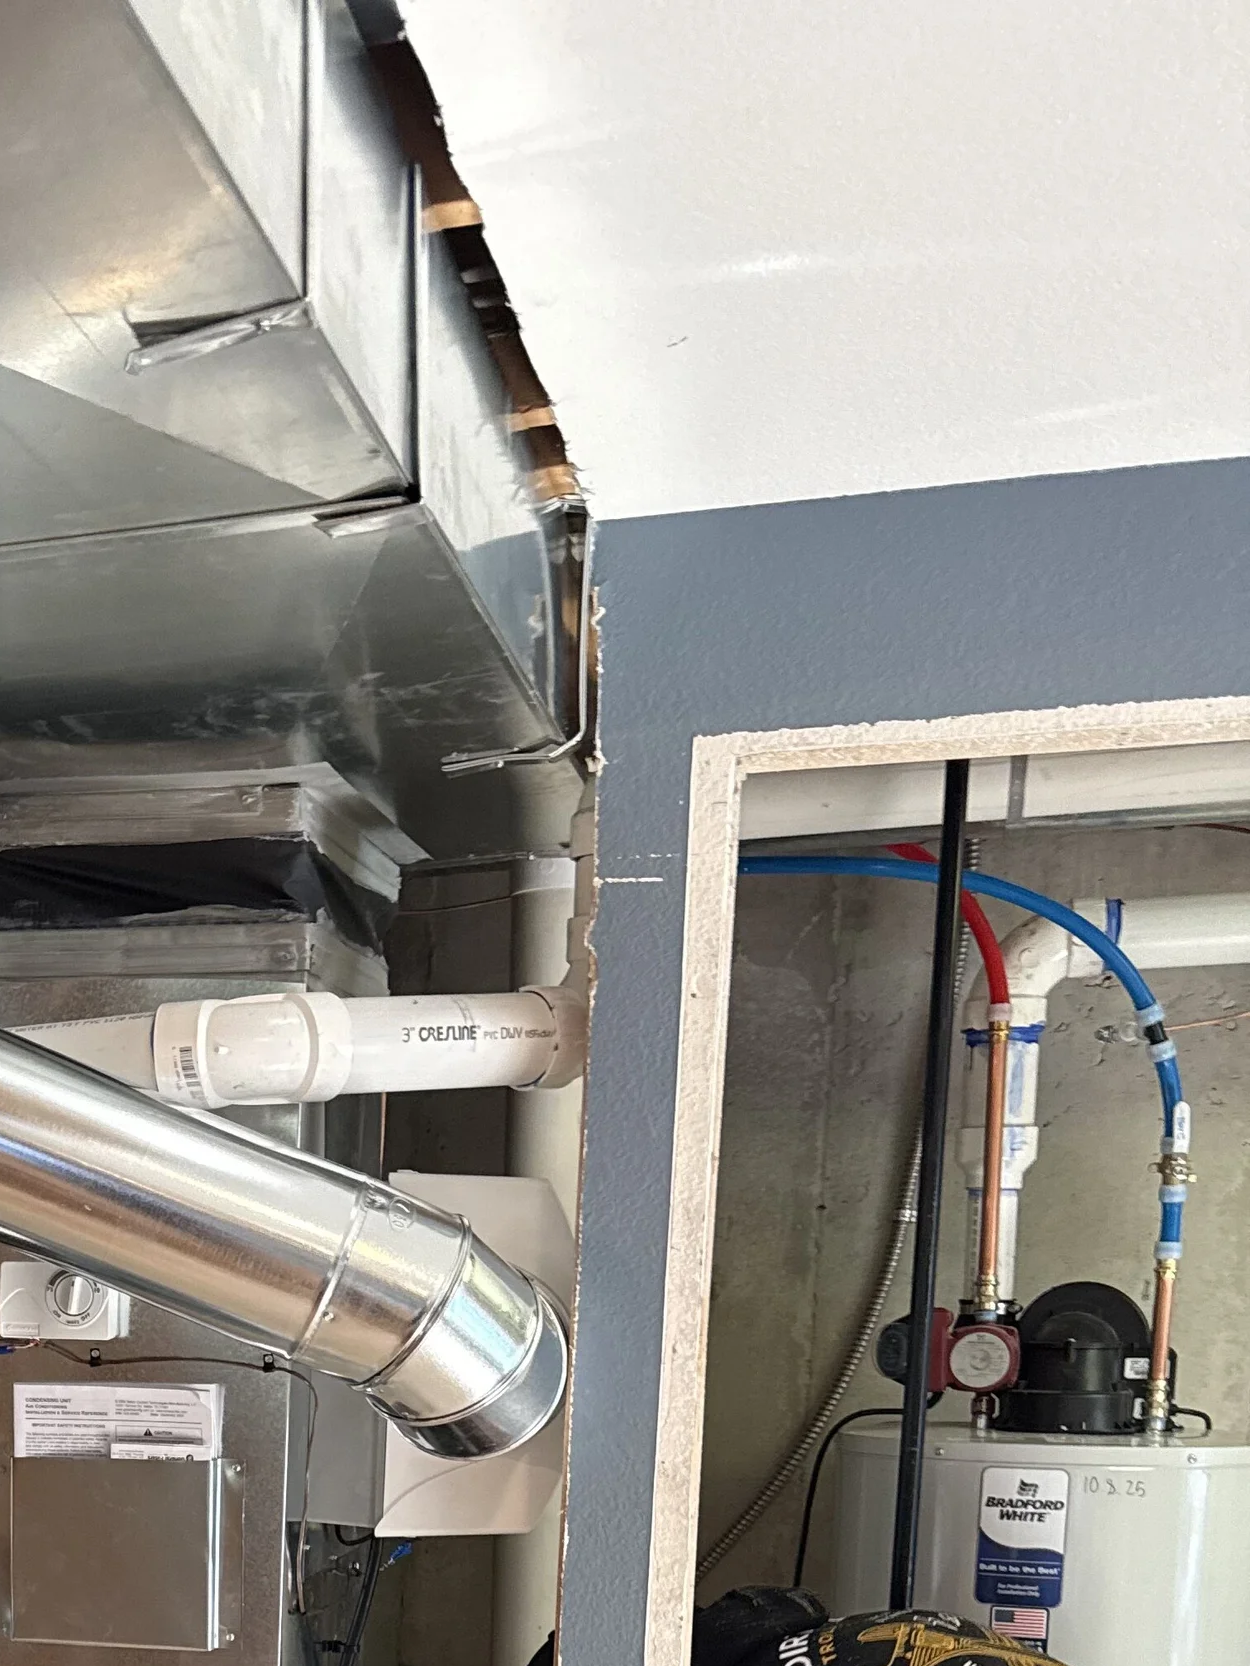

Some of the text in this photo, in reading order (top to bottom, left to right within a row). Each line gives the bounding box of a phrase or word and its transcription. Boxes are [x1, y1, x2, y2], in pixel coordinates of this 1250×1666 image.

[402, 1027, 415, 1042] 3"
[484, 1031, 498, 1040] PVC
[501, 1027, 522, 1039] DWV
[985, 1496, 1065, 1510] BRADFORD
[999, 1510, 1047, 1522] WHITE
